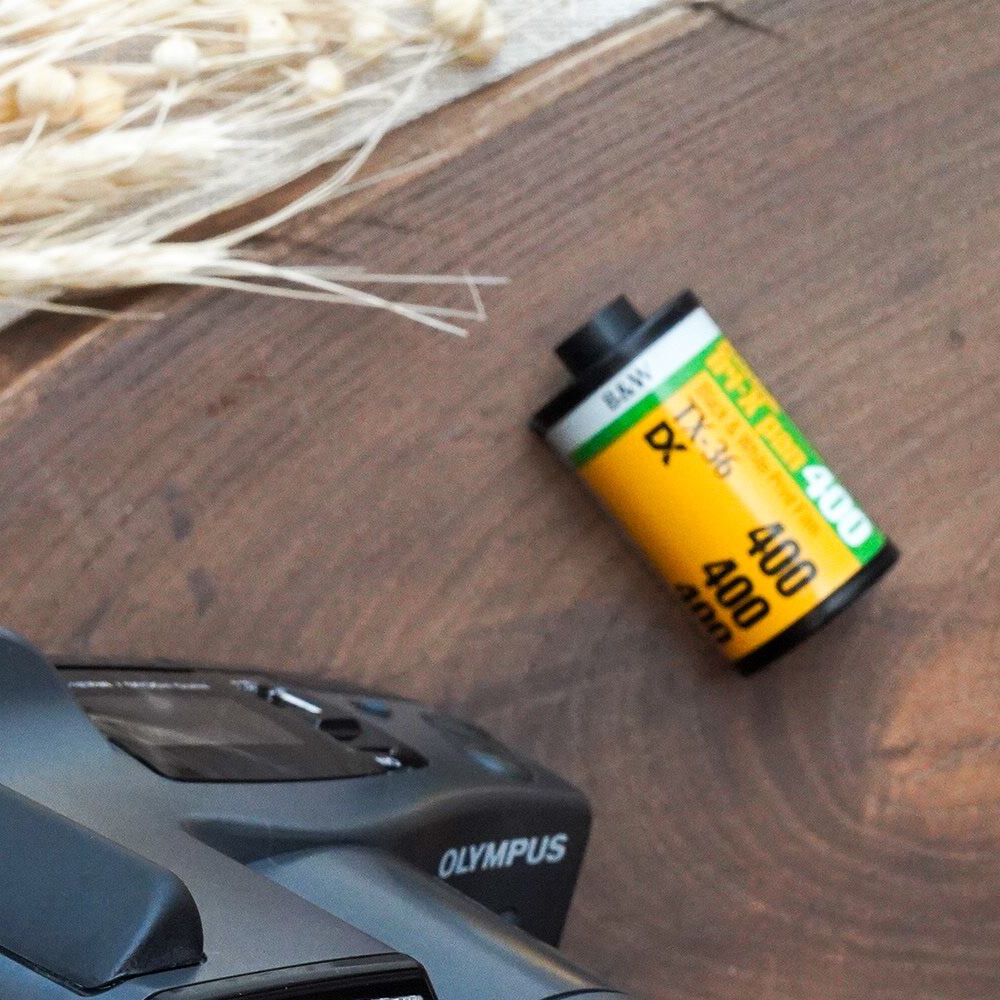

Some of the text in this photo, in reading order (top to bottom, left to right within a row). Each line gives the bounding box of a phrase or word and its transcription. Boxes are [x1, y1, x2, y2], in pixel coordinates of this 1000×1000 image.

[644, 421, 687, 467] DX
[674, 402, 733, 479] TX-36
[799, 463, 873, 548] 400
[702, 559, 770, 630] 400
[746, 521, 819, 599] 400
[438, 831, 569, 880] OLYMPUS
